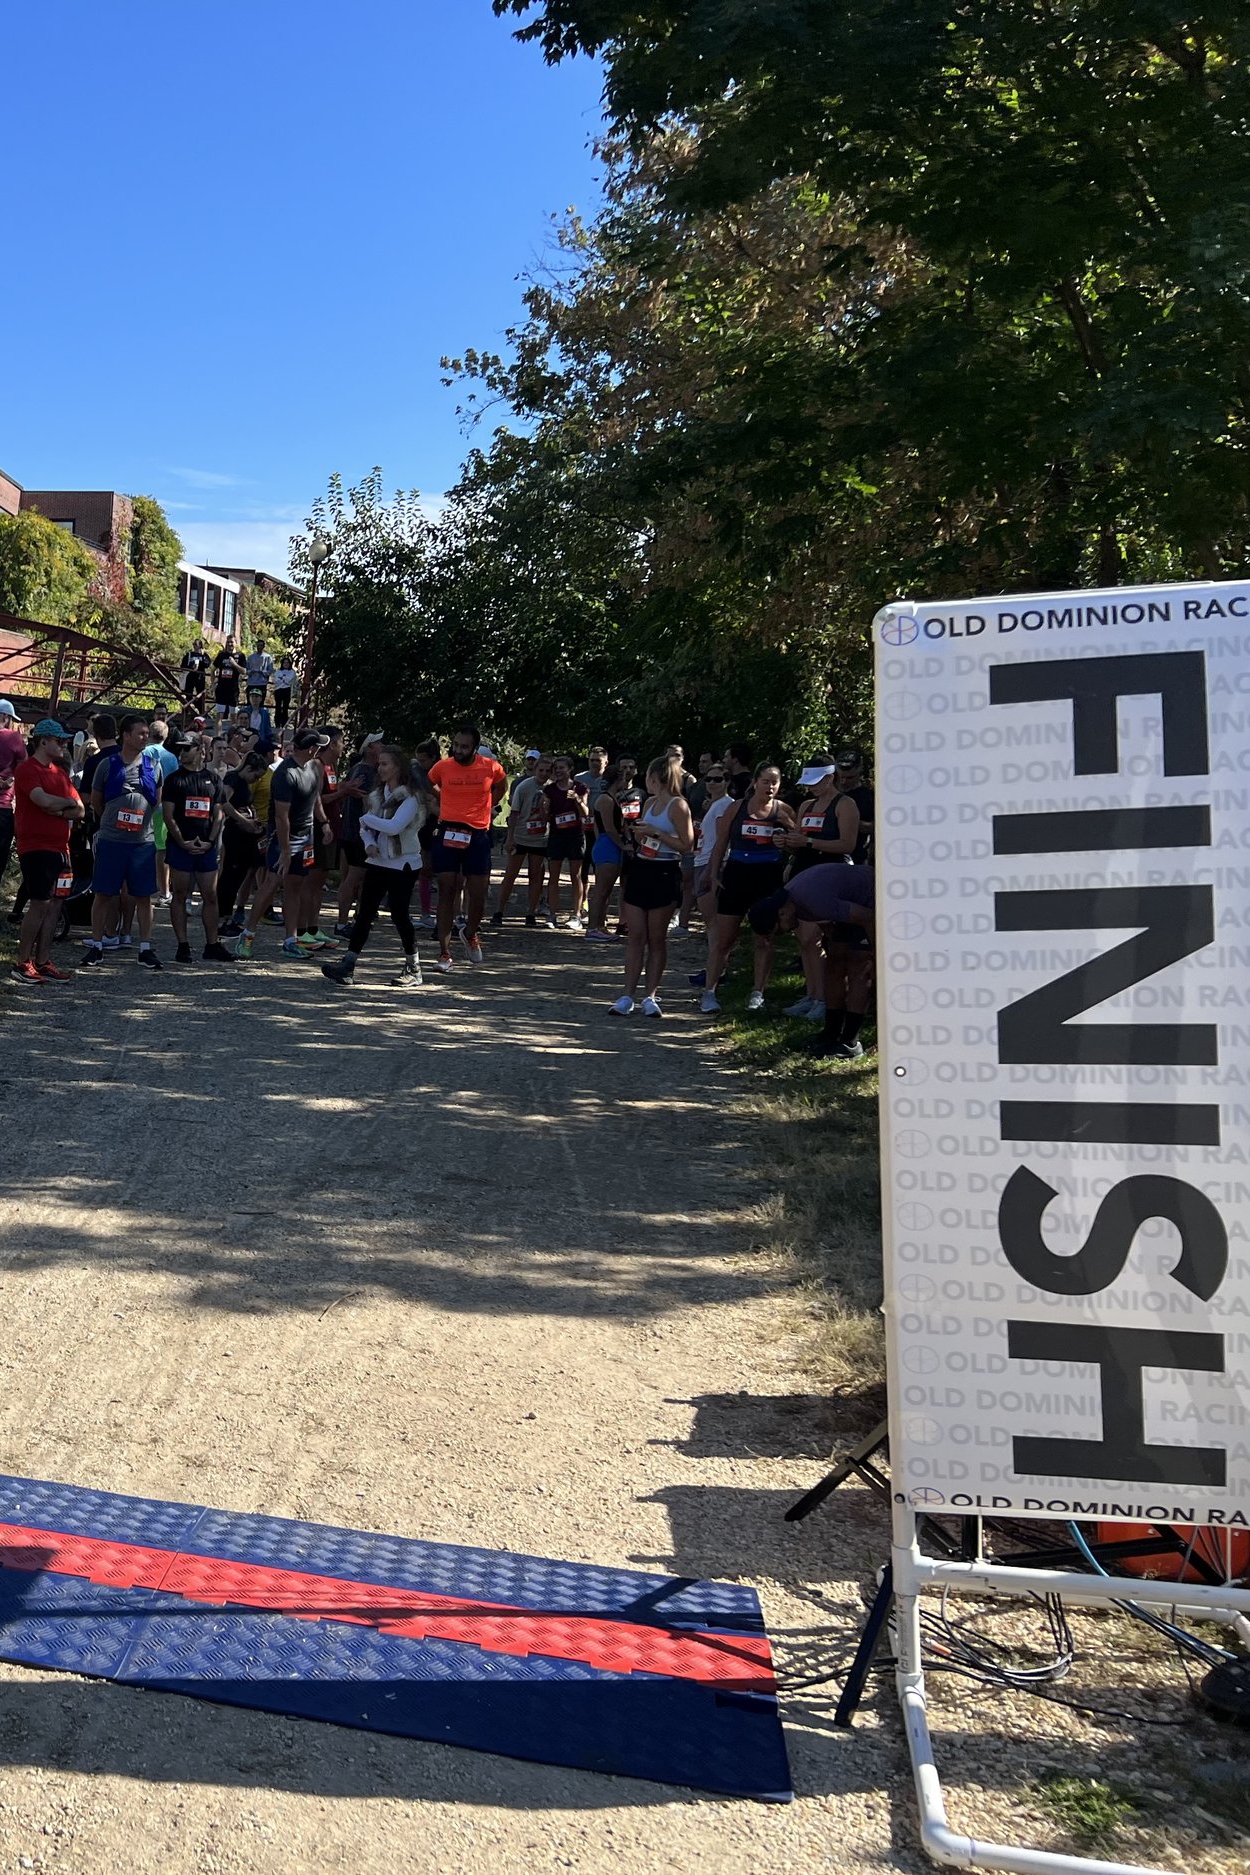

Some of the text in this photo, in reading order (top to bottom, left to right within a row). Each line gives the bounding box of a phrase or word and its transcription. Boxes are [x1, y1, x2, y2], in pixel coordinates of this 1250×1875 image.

[924, 615, 986, 639] OLD
[998, 601, 1171, 634] DOMINION
[883, 657, 945, 680] OLD
[927, 691, 988, 714] OLD
[884, 731, 946, 753] OLD
[928, 765, 990, 788] OLD
[189, 802, 199, 810] 83
[885, 805, 947, 827] OLD
[122, 813, 131, 822] 13
[746, 826, 757, 834] 45
[929, 839, 991, 862] OLD
[886, 878, 949, 900] OLD
[930, 913, 993, 935] OLD
[889, 951, 951, 973] OLD
[932, 987, 996, 1010] OLD
[891, 1024, 952, 1046] OLD
[934, 1061, 998, 1083] OLD
[1009, 1064, 1188, 1086] DOMINION
[989, 650, 1230, 1487] FINISH
[893, 1097, 954, 1119] OLD
[937, 1134, 999, 1156] OLD
[895, 1169, 957, 1192] OLD
[898, 1242, 959, 1264] OLD
[942, 1280, 1005, 1302] OLD
[901, 1313, 963, 1335] OLD
[945, 1351, 1008, 1374] OLD
[903, 1385, 966, 1408] OLD
[949, 1424, 1011, 1447] OLD
[907, 1456, 969, 1480] OLD
[950, 1493, 1013, 1509] OLD
[1023, 1498, 1195, 1523] DOMINION
